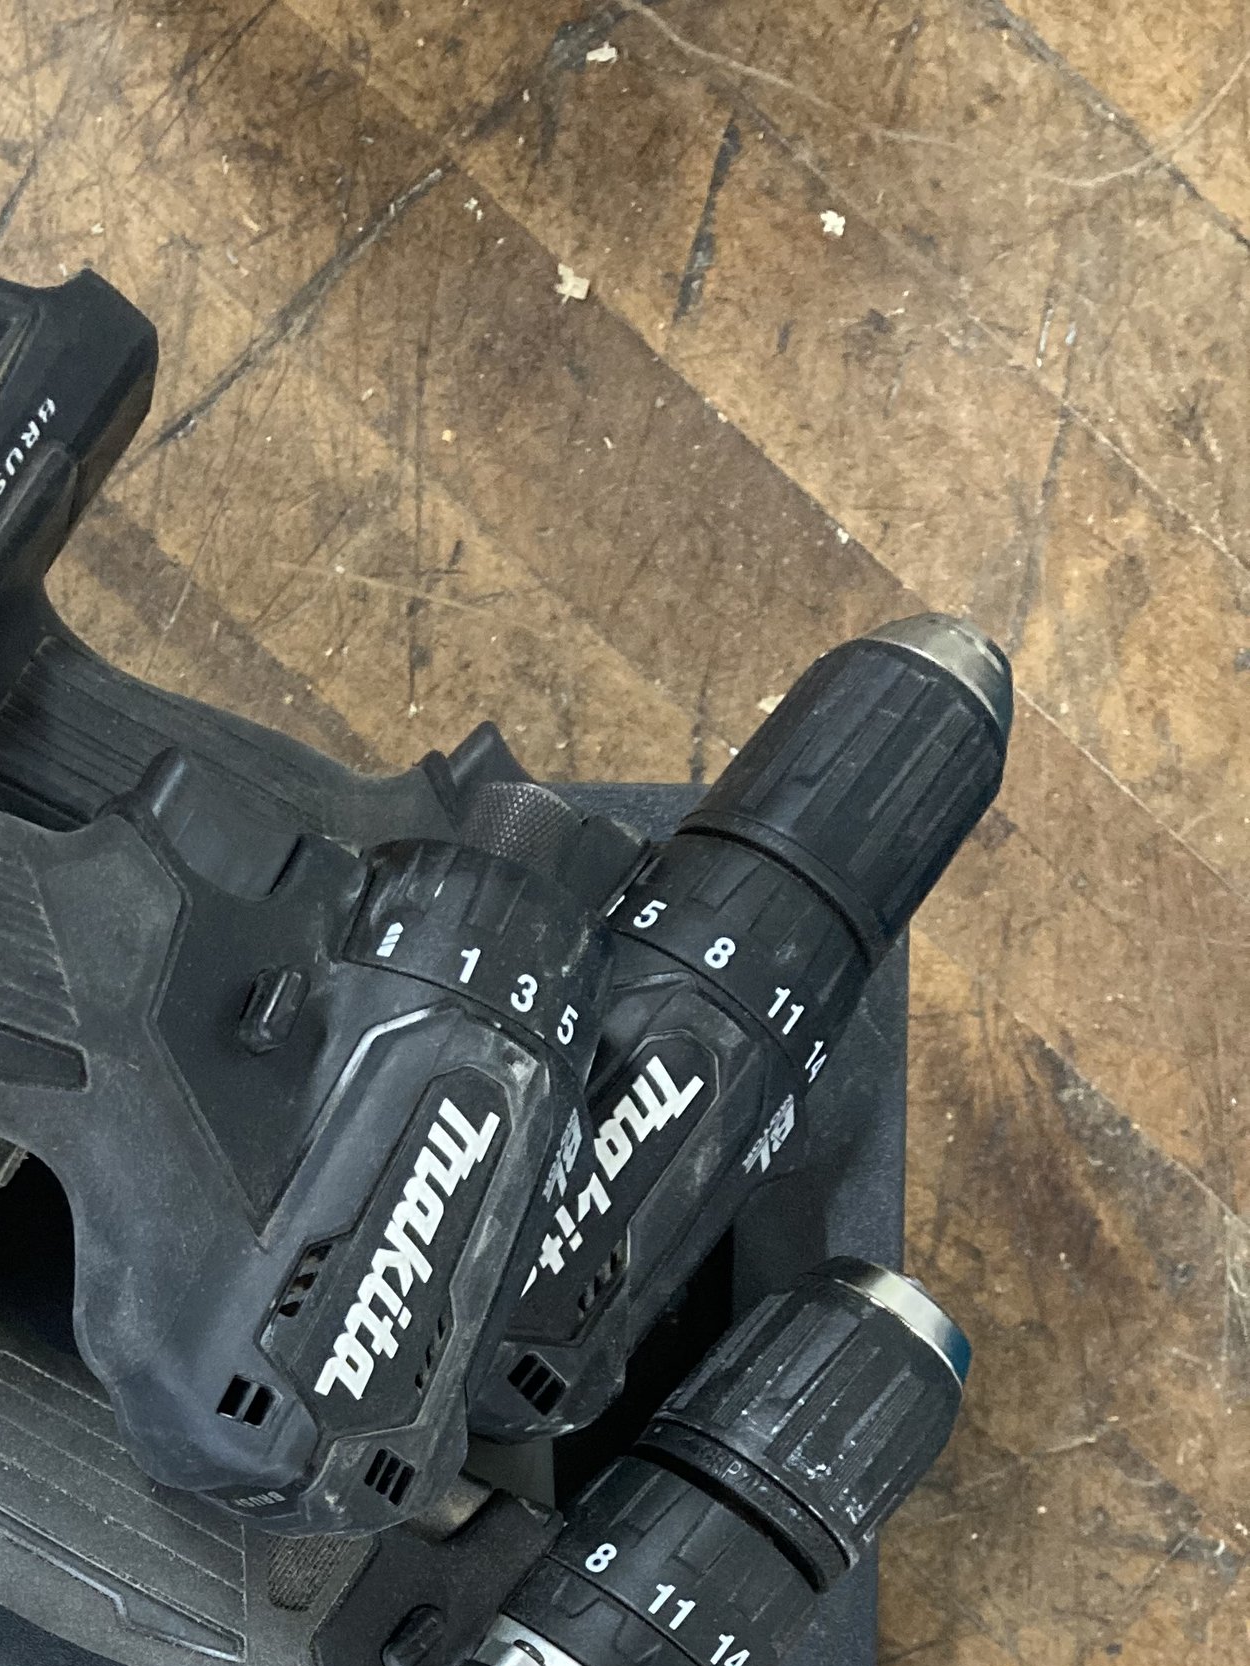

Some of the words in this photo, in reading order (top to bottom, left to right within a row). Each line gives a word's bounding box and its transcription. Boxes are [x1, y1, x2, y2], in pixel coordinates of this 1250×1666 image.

[459, 947, 481, 984] 1
[510, 973, 538, 1013] 3
[556, 1004, 579, 1046] 5
[633, 899, 668, 929] 5
[703, 936, 736, 969] 8
[767, 986, 805, 1035] 11
[804, 1040, 827, 1083] 14
[521, 1055, 706, 1298] makit
[585, 1542, 618, 1573] 8
[647, 1583, 696, 1631] 11
